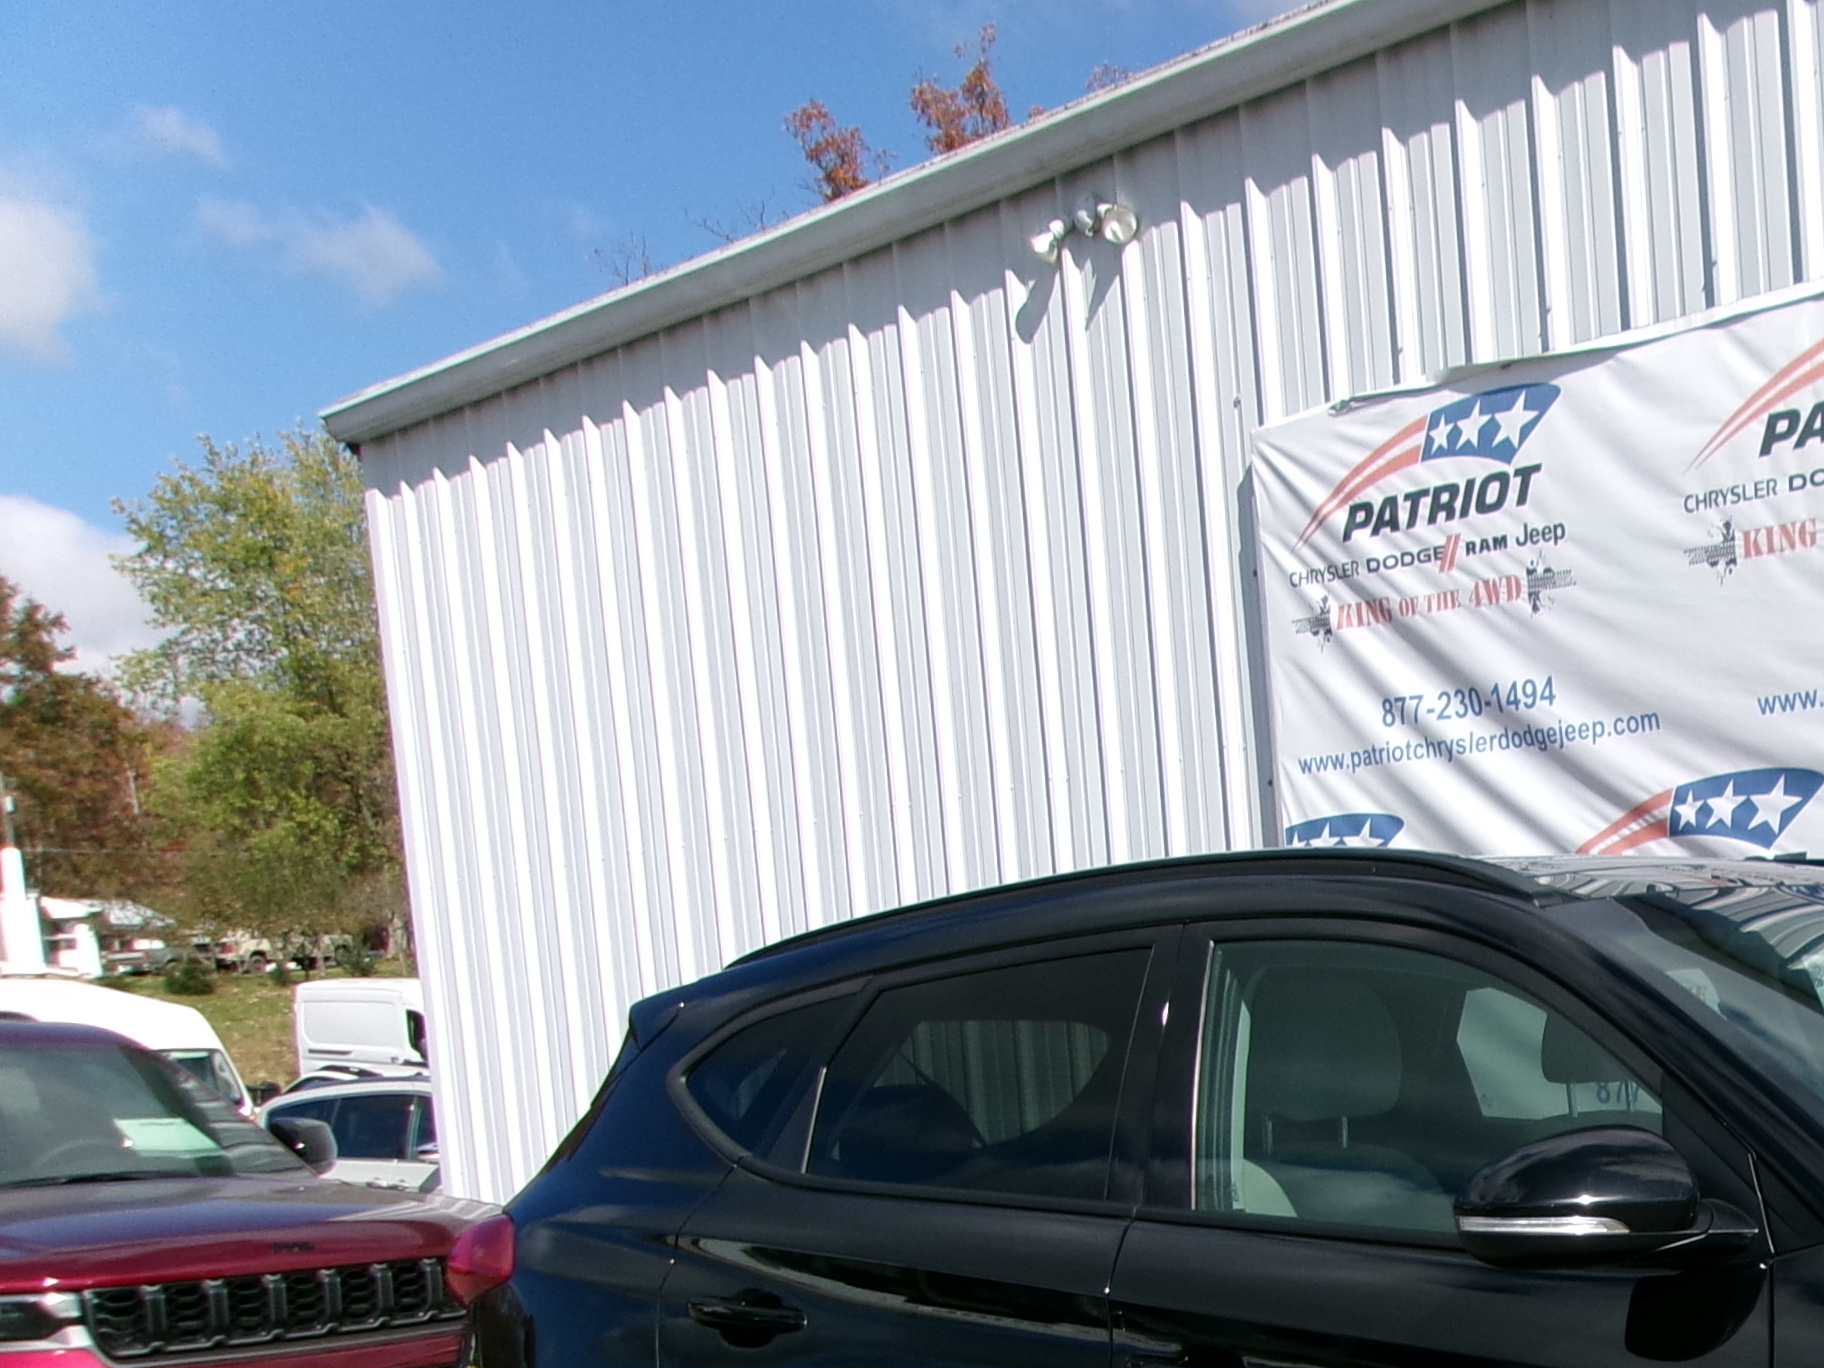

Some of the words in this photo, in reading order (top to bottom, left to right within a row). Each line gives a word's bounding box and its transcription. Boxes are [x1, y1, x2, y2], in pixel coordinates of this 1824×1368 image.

[1342, 463, 1542, 543] PATRIOT
[1683, 479, 1778, 514] CHRYSLER
[1289, 559, 1360, 588] CHRYSLER
[1366, 545, 1446, 574] DODGE
[1465, 534, 1508, 558] RAM
[1515, 520, 1567, 547] Jeep
[1741, 519, 1818, 560] KING
[1336, 597, 1393, 631] KING
[1398, 595, 1420, 617] OF
[1423, 589, 1462, 613] THE
[1468, 574, 1523, 608] 4WD
[1381, 675, 1557, 728] 877-230-1494
[1298, 710, 1662, 776] www.patriotchryslerdodgejeep.com
